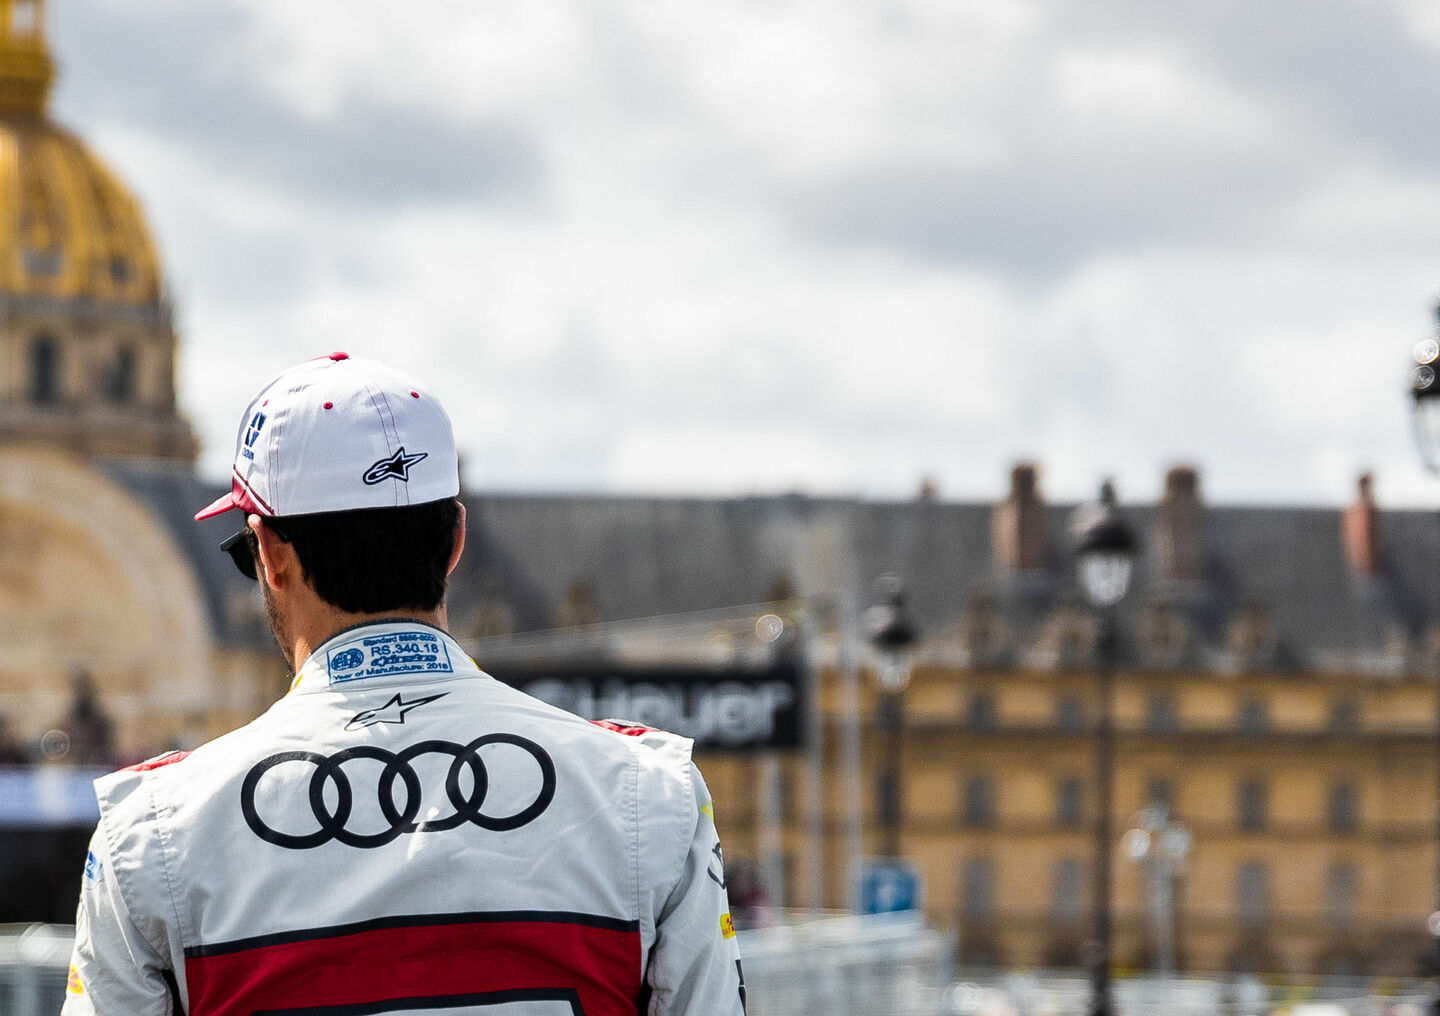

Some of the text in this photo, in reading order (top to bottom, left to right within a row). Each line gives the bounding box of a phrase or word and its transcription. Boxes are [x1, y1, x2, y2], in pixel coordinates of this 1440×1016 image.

[363, 635, 397, 646] Standard
[370, 643, 439, 657] RS.340.18
[354, 669, 364, 677] of
[366, 664, 425, 676] Manufacture:
[427, 662, 449, 670] 2018
